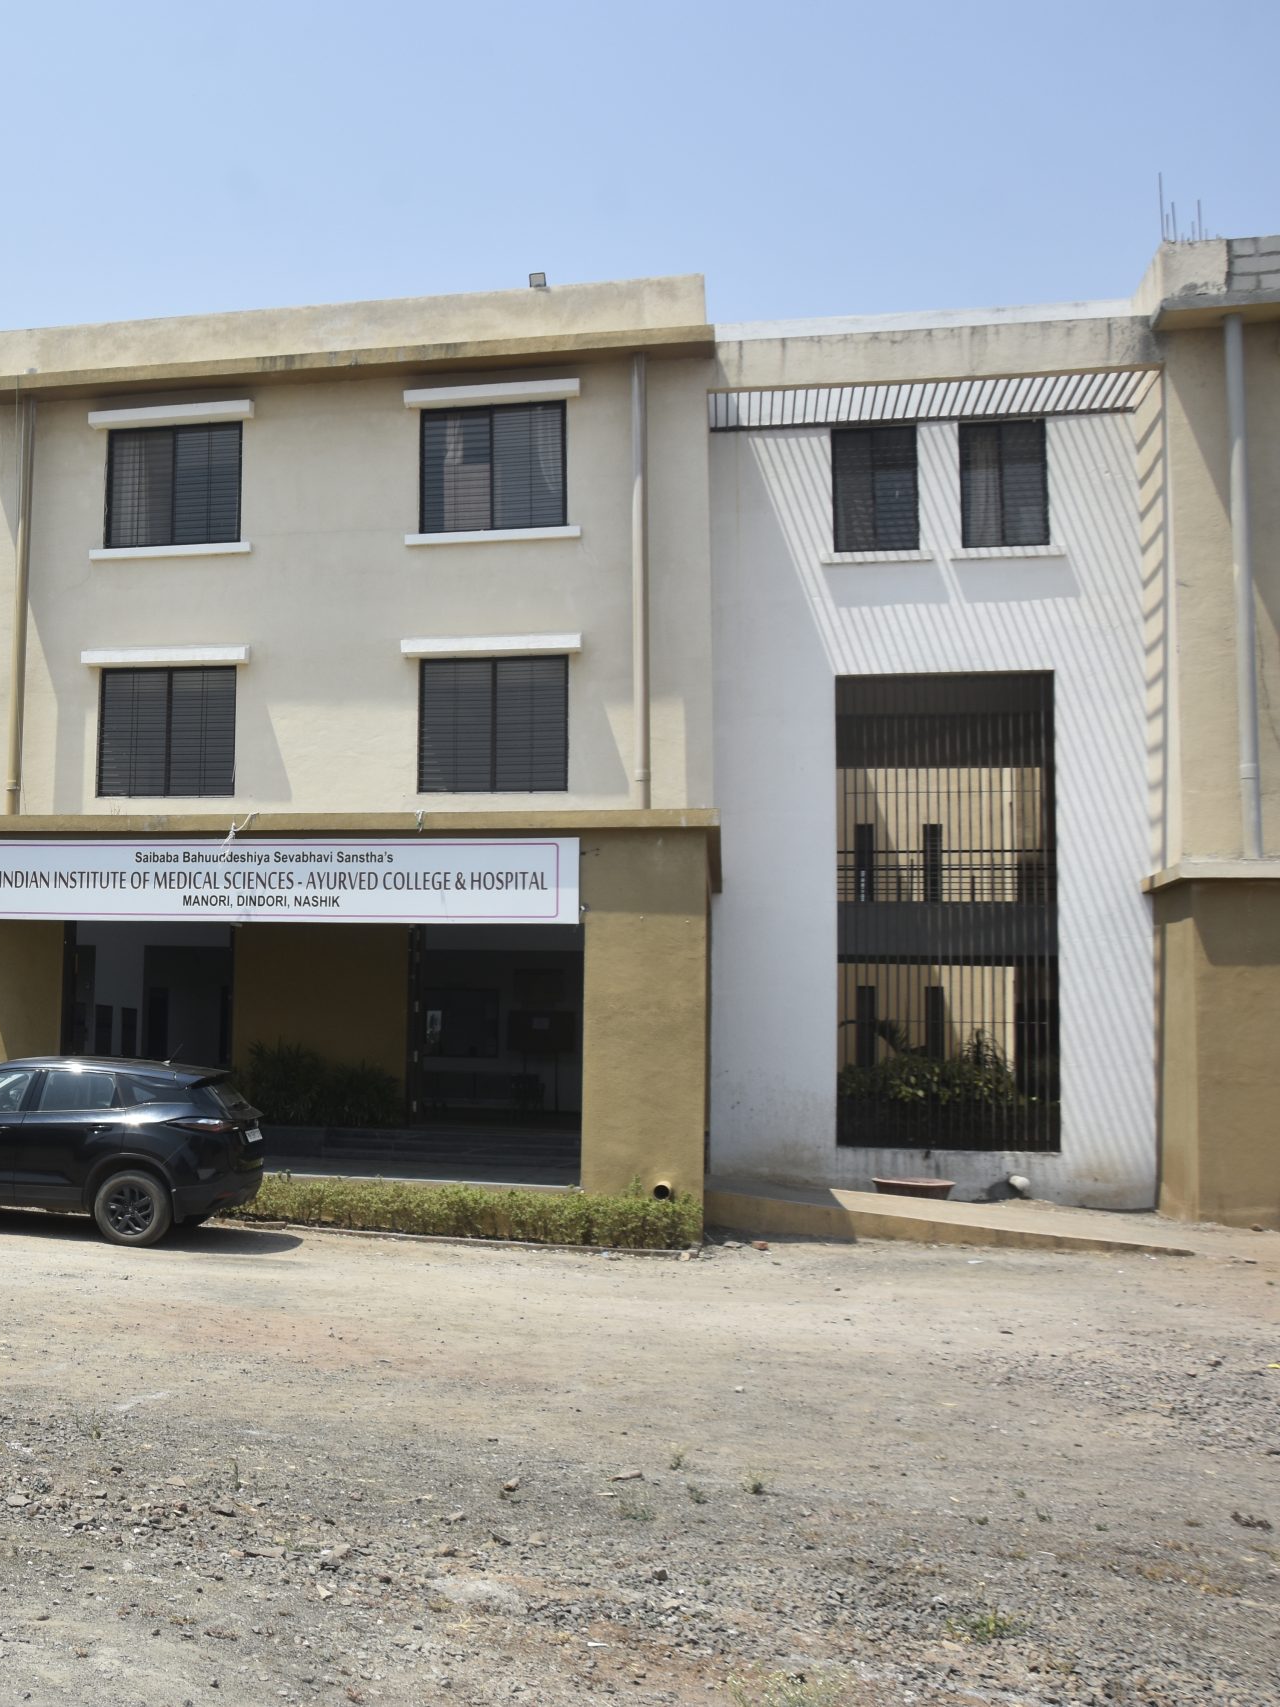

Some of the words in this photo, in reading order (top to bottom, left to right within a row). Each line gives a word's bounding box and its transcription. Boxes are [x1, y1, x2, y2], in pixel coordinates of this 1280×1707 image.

[135, 852, 179, 863] Saibaba
[183, 852, 270, 865] Bahuuddeshiya
[274, 851, 332, 863] Sevabhavi
[337, 851, 393, 863] Sanstha's
[0, 871, 50, 888] INDIAN
[54, 871, 126, 889] INSTITUTE
[131, 872, 150, 889] OF
[154, 871, 220, 889] MEDICAL
[224, 872, 294, 889] SCIENCES
[306, 872, 378, 890] AYURVED
[383, 872, 451, 890] COLLEGE
[455, 872, 466, 890] &
[471, 872, 547, 890] HOSPITAL
[183, 895, 232, 908] MANORI,
[237, 895, 289, 908] DINDORI,
[294, 896, 340, 907] NASHIK
